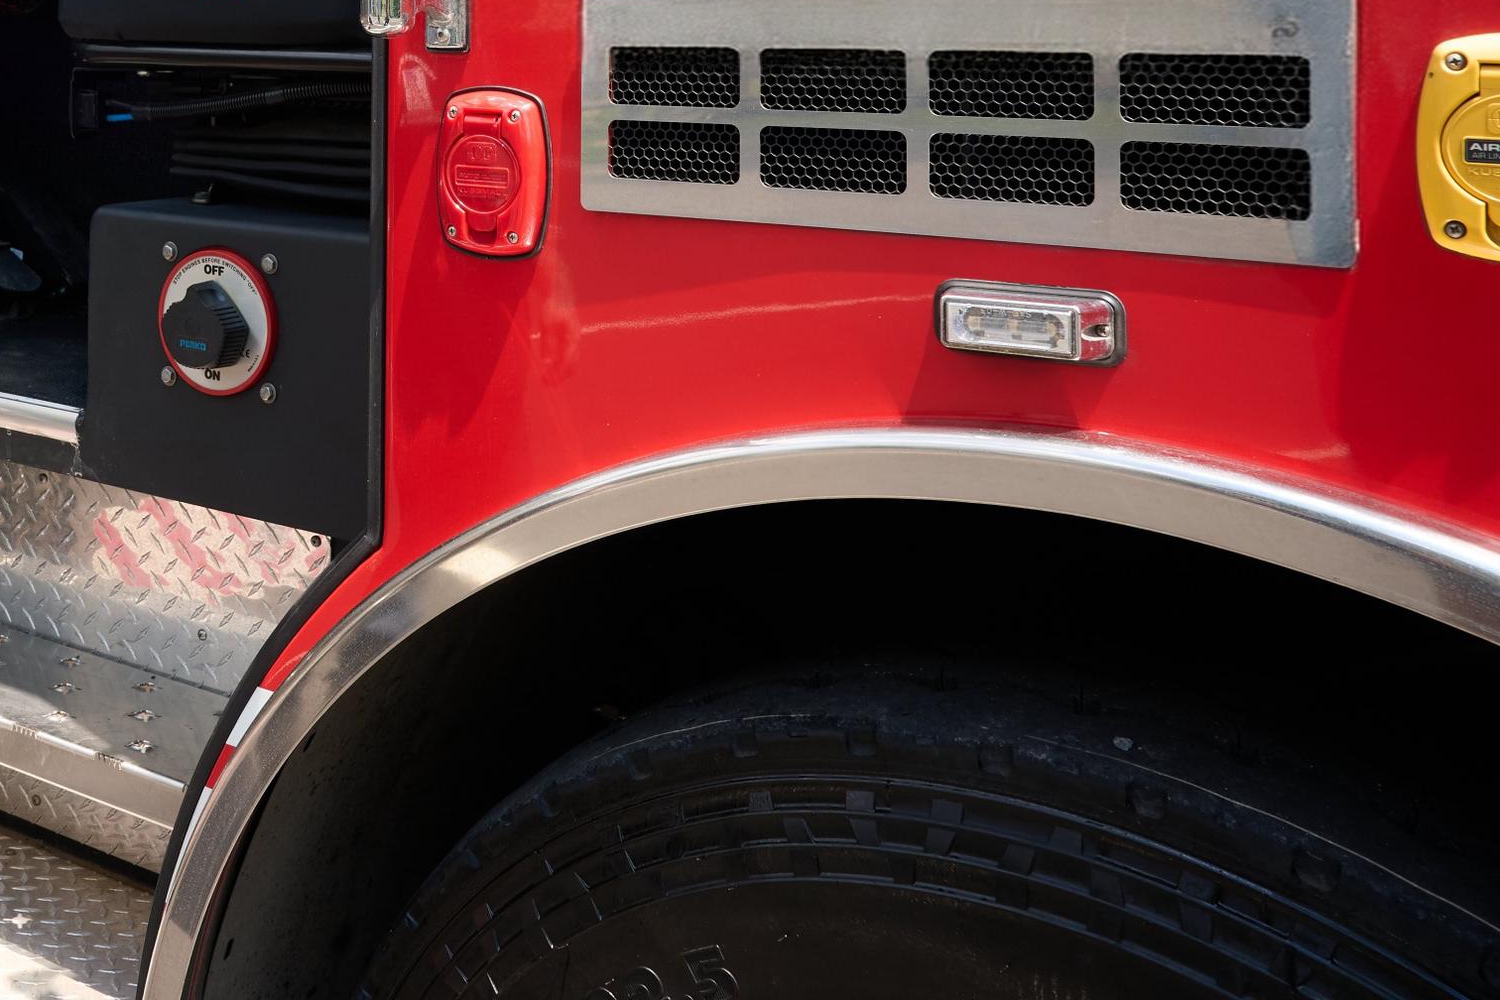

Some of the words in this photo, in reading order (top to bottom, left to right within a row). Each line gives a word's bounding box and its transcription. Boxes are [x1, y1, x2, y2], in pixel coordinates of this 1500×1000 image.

[173, 270, 183, 285] STOP
[181, 259, 201, 275] ENGINES
[221, 260, 247, 281] SWITCHING
[203, 264, 225, 277] OFF
[180, 339, 207, 351] PERKO
[204, 369, 221, 381] ON
